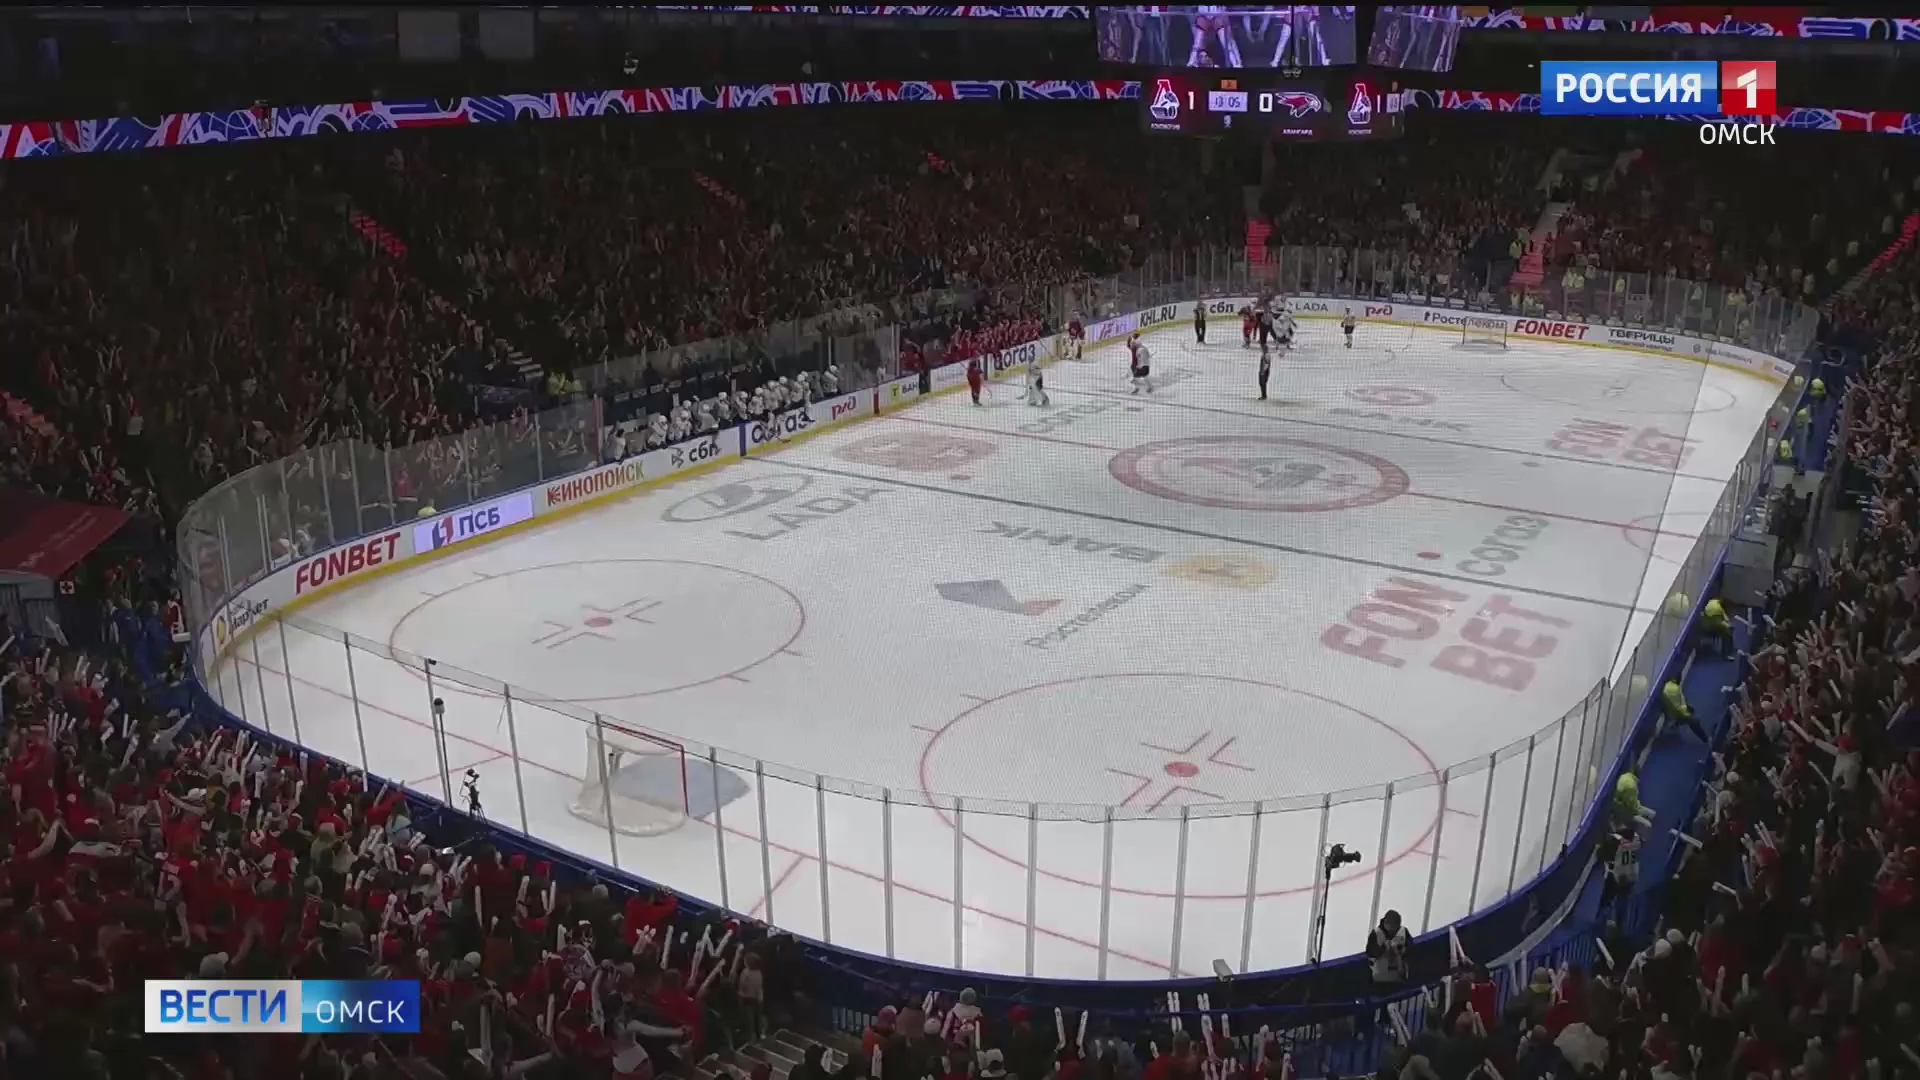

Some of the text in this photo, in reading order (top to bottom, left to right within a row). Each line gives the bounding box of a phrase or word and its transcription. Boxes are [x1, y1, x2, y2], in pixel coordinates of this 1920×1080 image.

[1187, 91, 1194, 110] 1
[1258, 93, 1273, 112] 0
[1140, 305, 1177, 327] KHL.RU
[1295, 304, 1328, 312] LADA
[1514, 319, 1589, 340] FONBET
[1608, 328, 1675, 345] ТВЕРИЦЫ
[547, 461, 645, 507] КИНОПОИСК
[458, 507, 500, 537] ПСБ
[295, 532, 400, 596] FONBET
[1321, 577, 1471, 669] FON
[1430, 595, 1573, 691] BET
